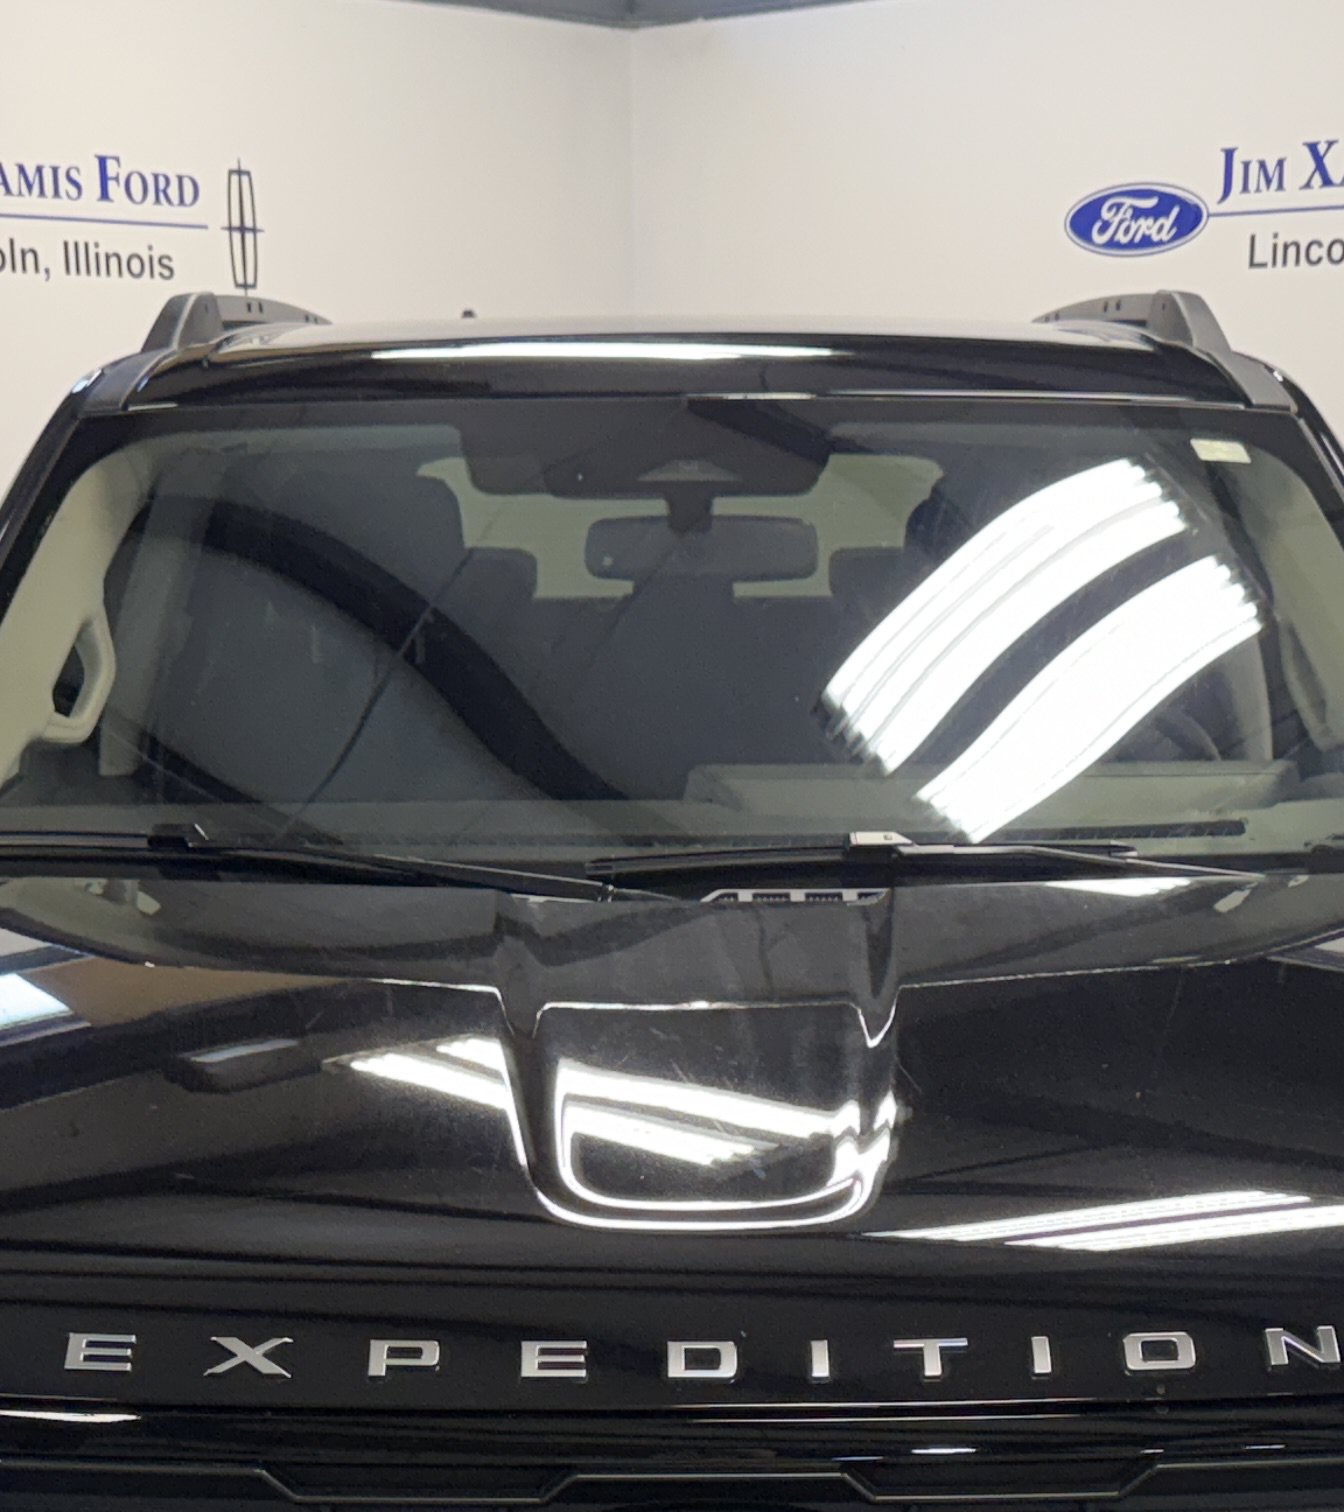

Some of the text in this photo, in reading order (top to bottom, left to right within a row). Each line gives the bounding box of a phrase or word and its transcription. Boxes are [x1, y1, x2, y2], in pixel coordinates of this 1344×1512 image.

[94, 155, 199, 207] FORD
[1218, 147, 1287, 203] JIM
[1091, 198, 1177, 245] Ford
[64, 241, 175, 280] Illinois
[64, 1325, 1343, 1381] EXPEDITION
